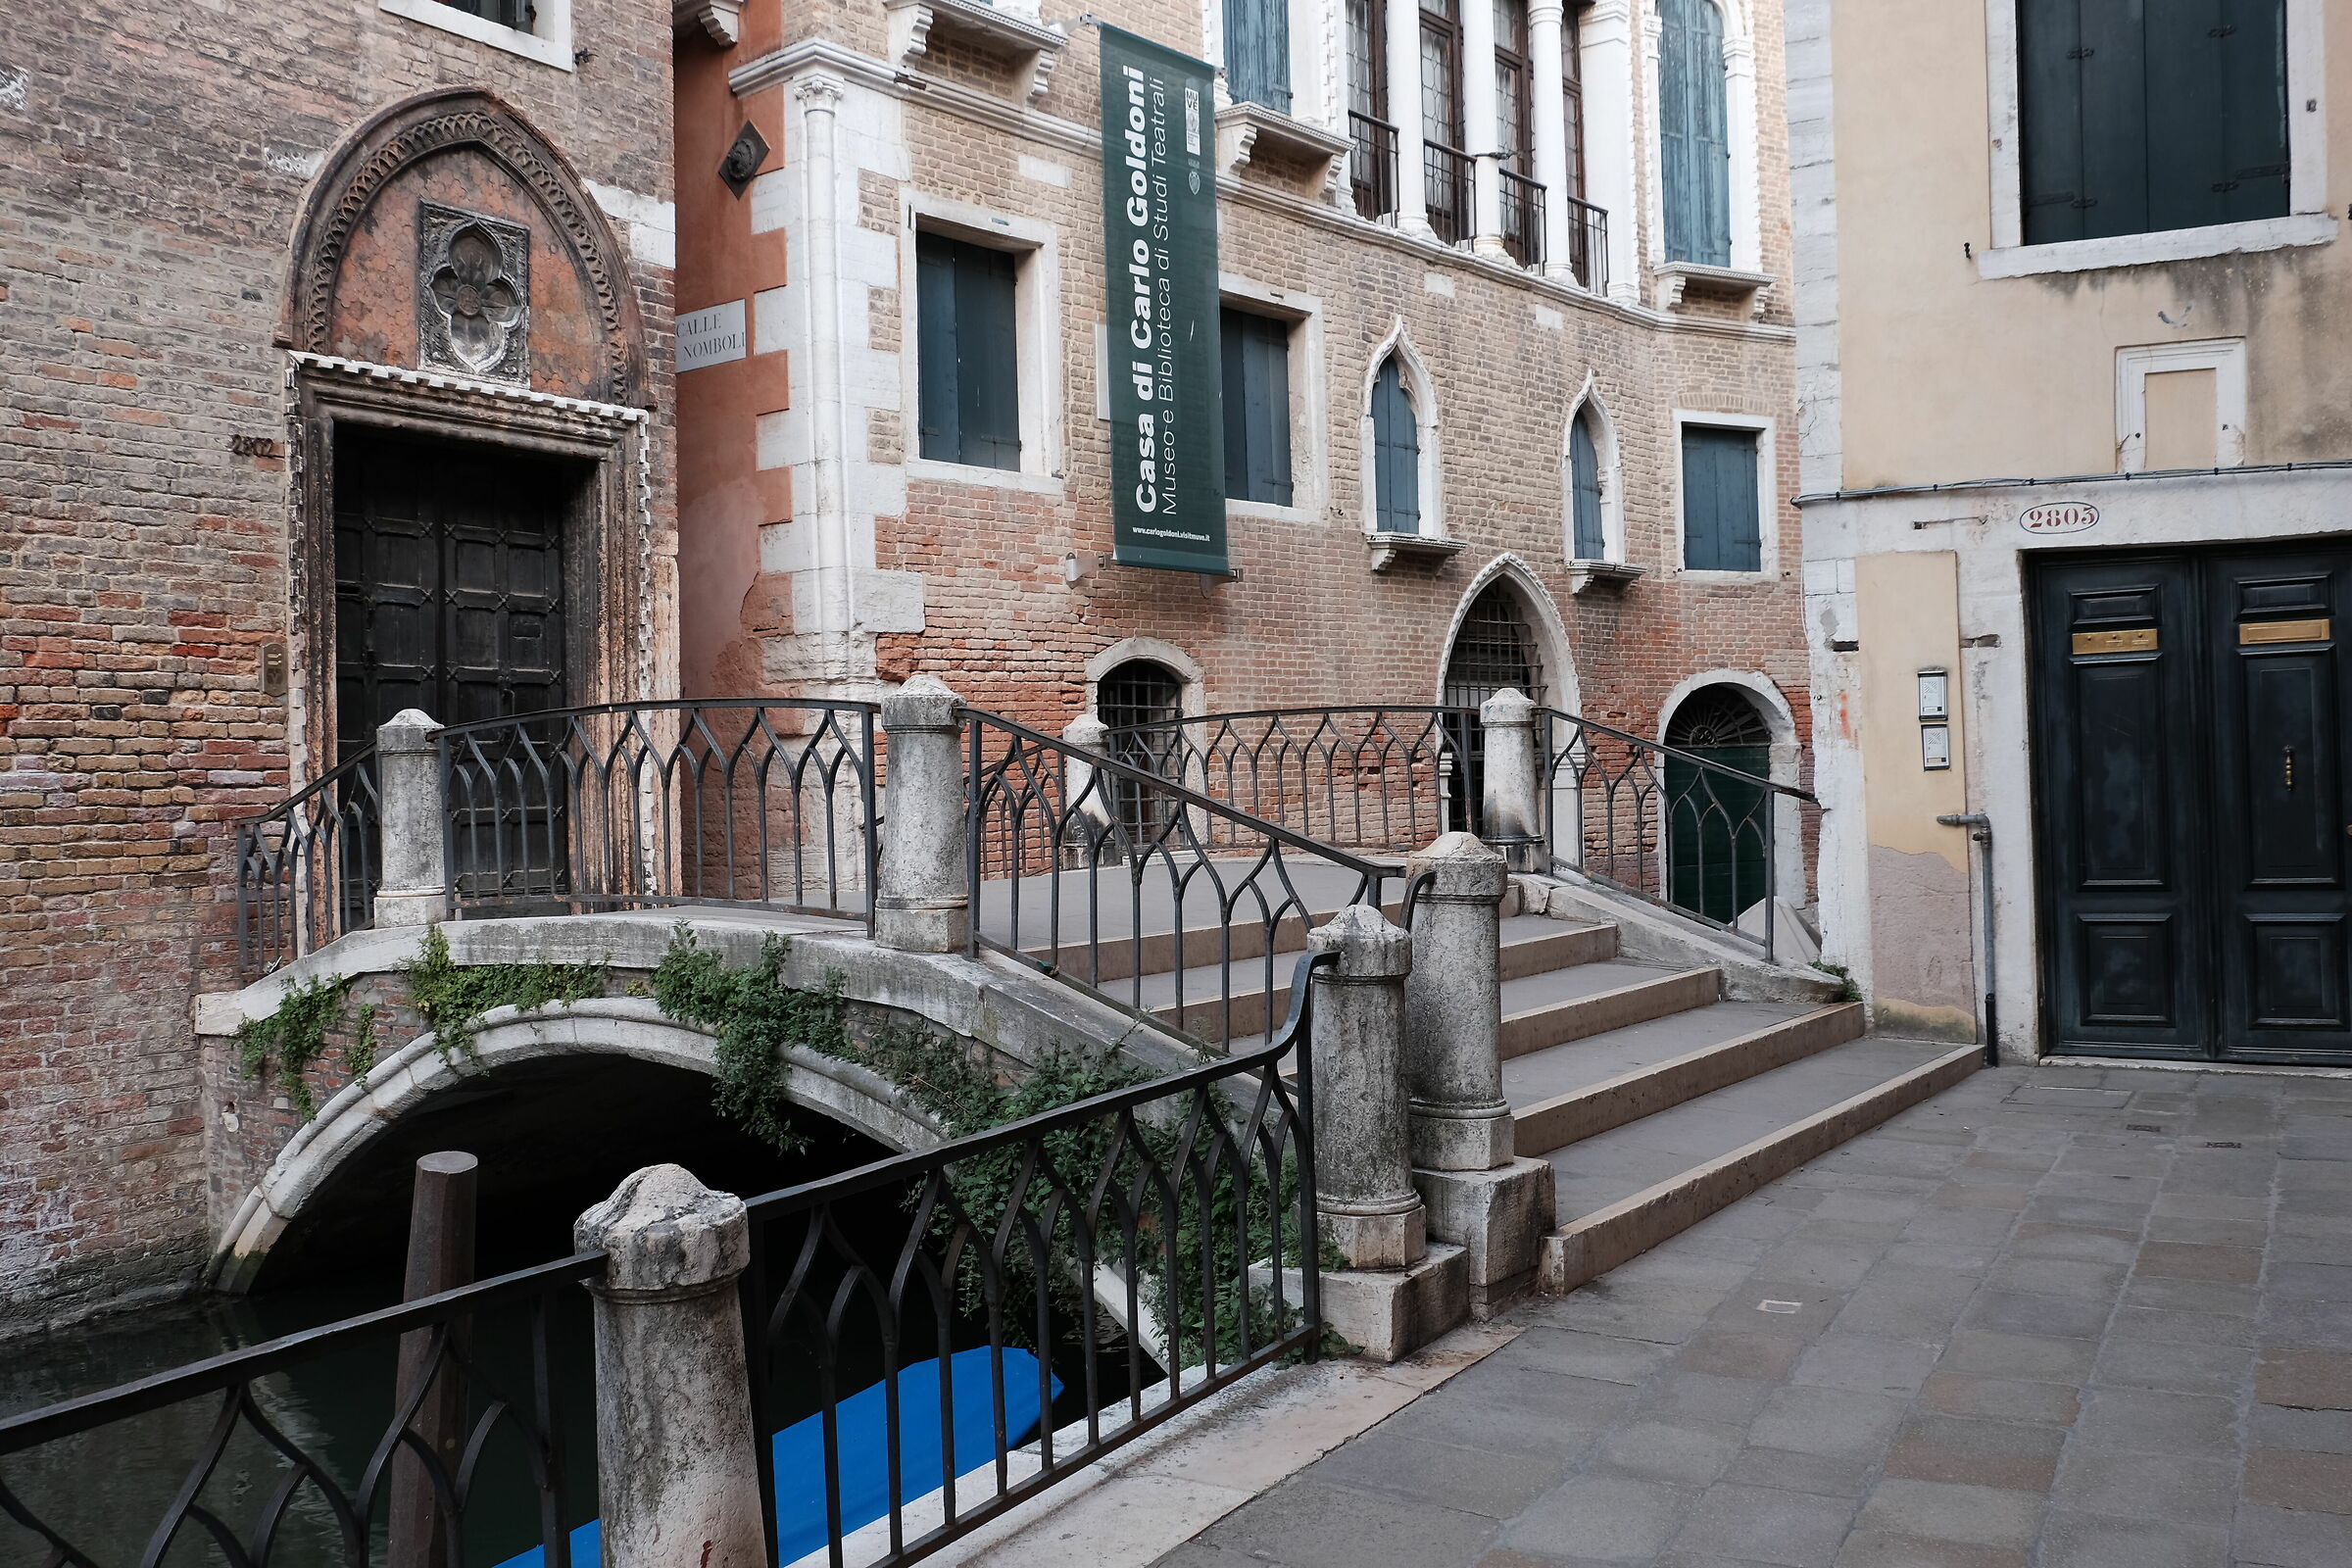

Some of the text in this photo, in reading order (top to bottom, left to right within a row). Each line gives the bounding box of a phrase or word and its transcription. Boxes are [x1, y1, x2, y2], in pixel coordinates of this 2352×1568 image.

[676, 313, 721, 338] CALLE
[683, 332, 746, 361] NOMBOLI
[1122, 65, 1157, 513] Casa di Carlo Goldoni
[1150, 77, 1177, 515] Museo e Biblioteca di Studi Teatrali
